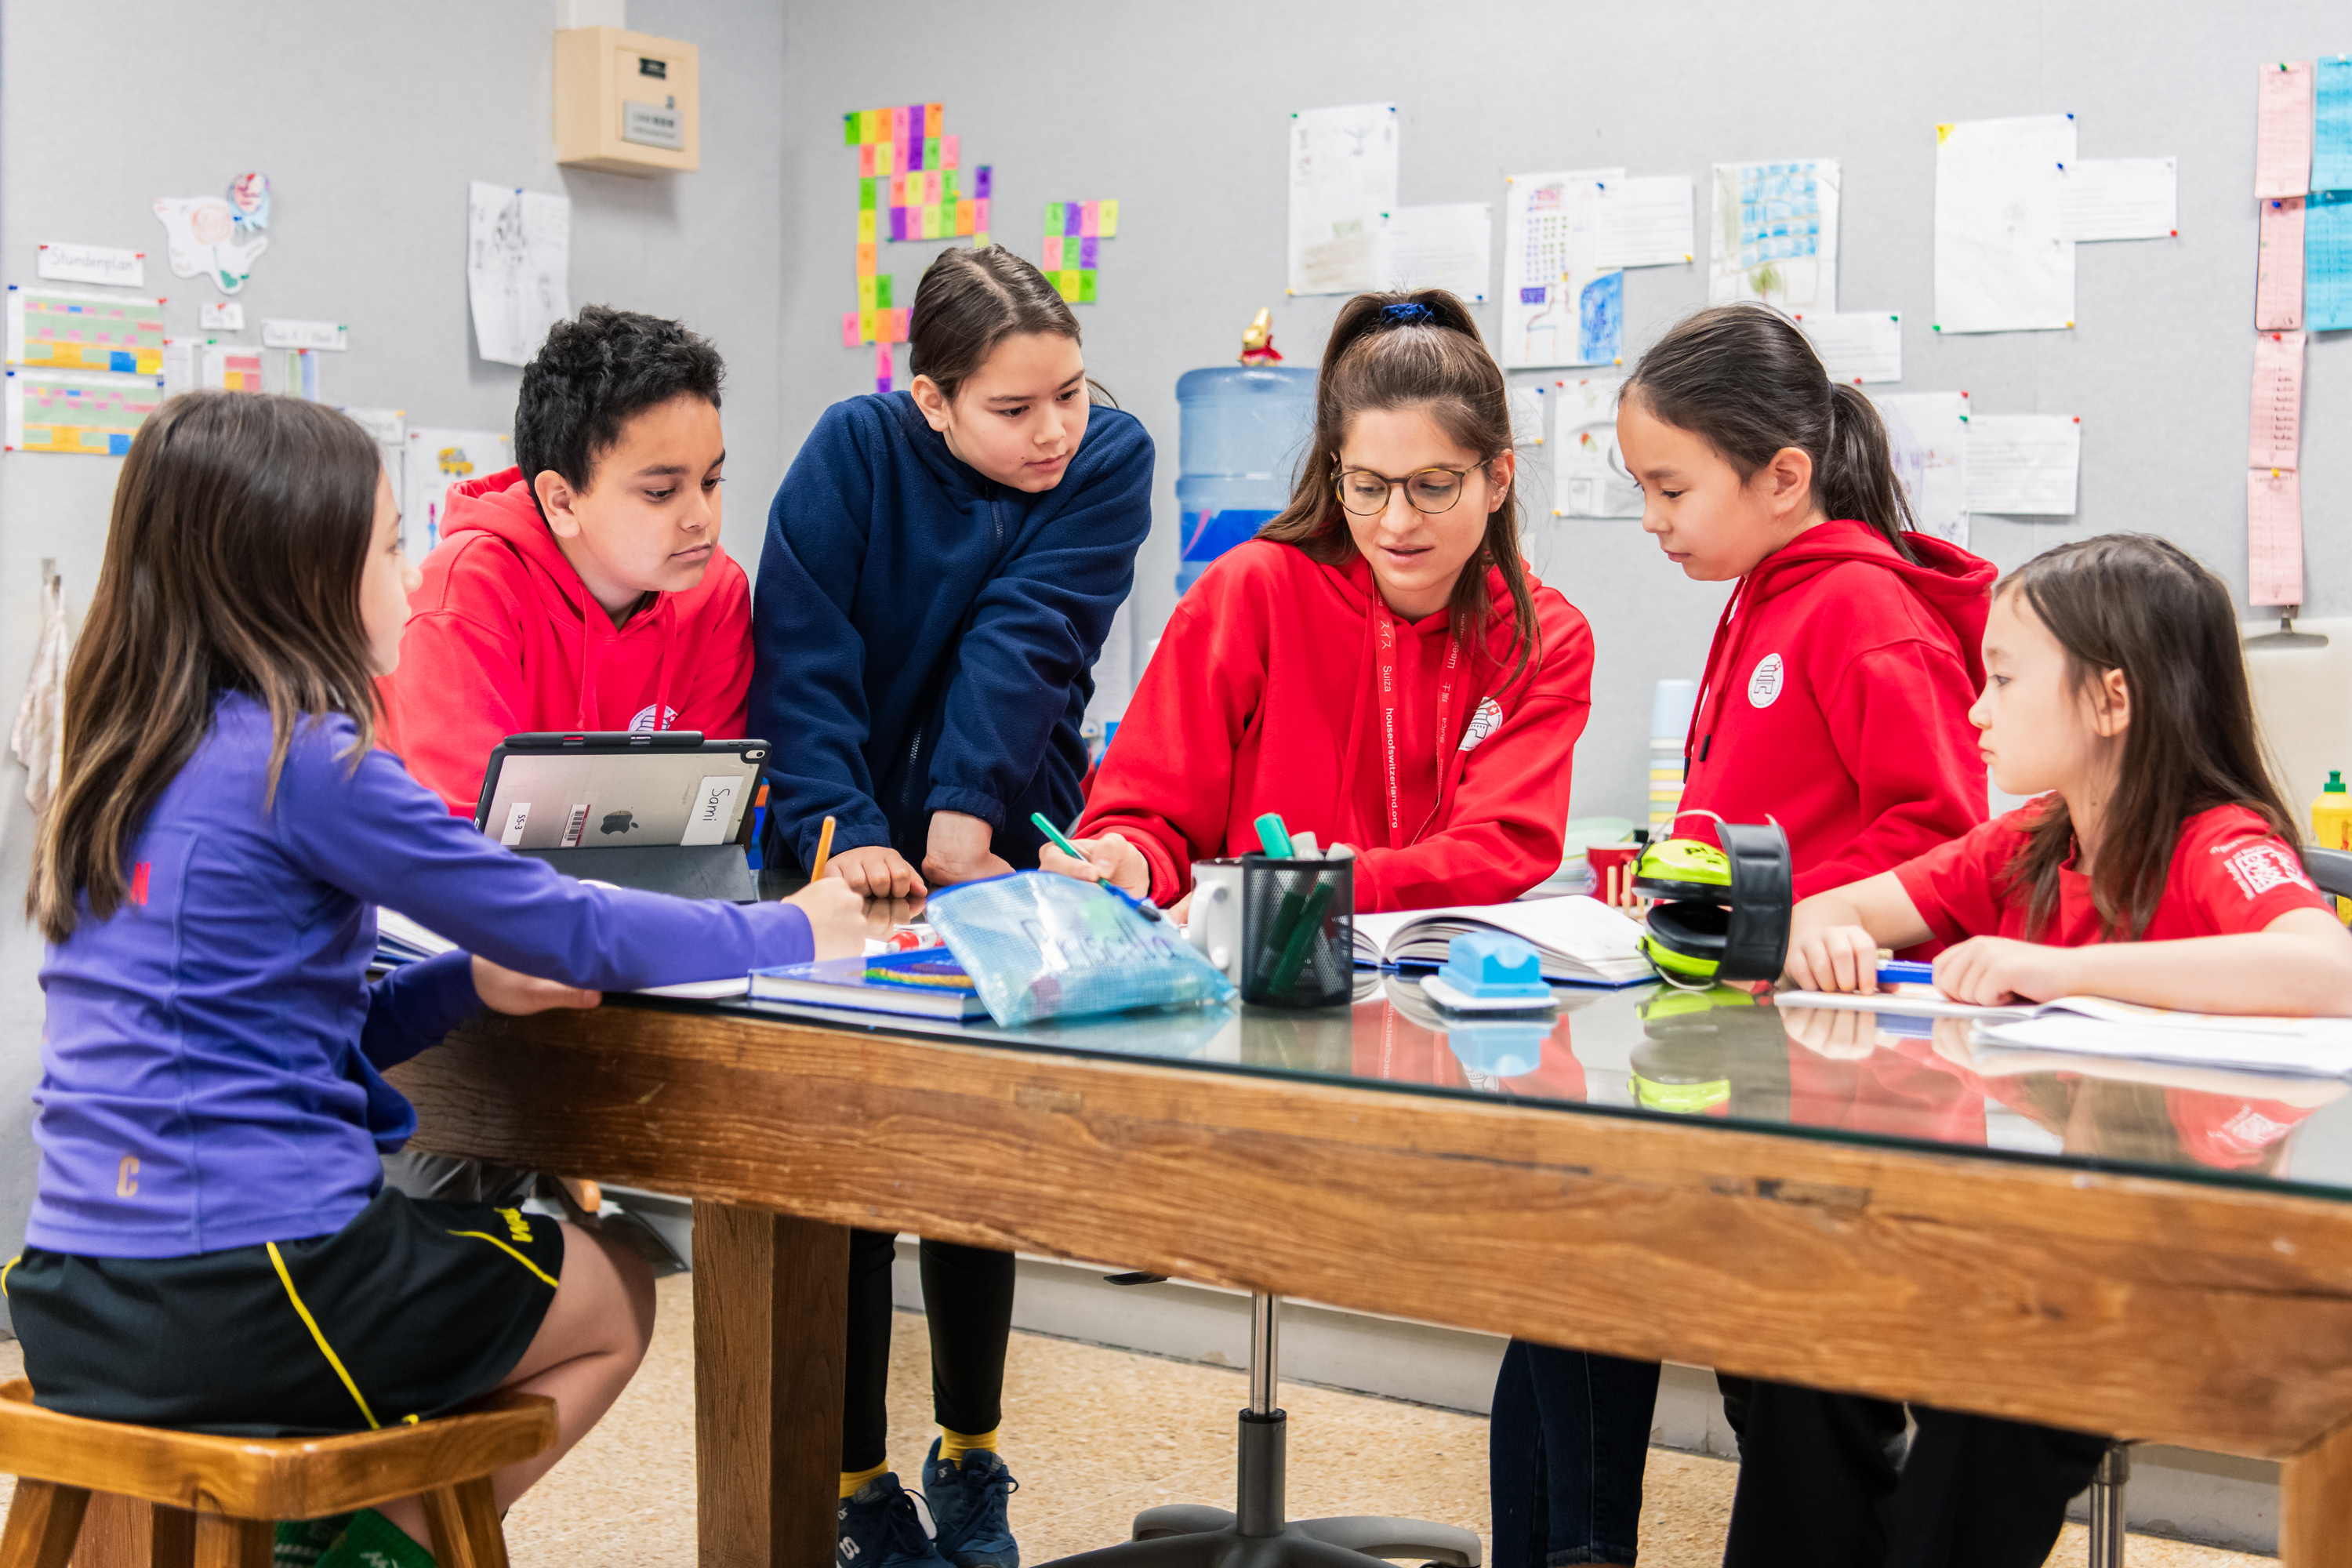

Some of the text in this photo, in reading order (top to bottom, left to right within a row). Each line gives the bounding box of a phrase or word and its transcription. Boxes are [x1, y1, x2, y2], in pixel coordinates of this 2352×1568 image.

[1380, 619, 1392, 650] スイス
[1382, 665, 1392, 692] Suiza
[1441, 681, 1451, 703] 瑞士
[1385, 707, 1399, 829] houseofswitzerland.org
[702, 788, 731, 821] Sami
[514, 814, 526, 830] SS-3
[116, 1156, 140, 1197] C
